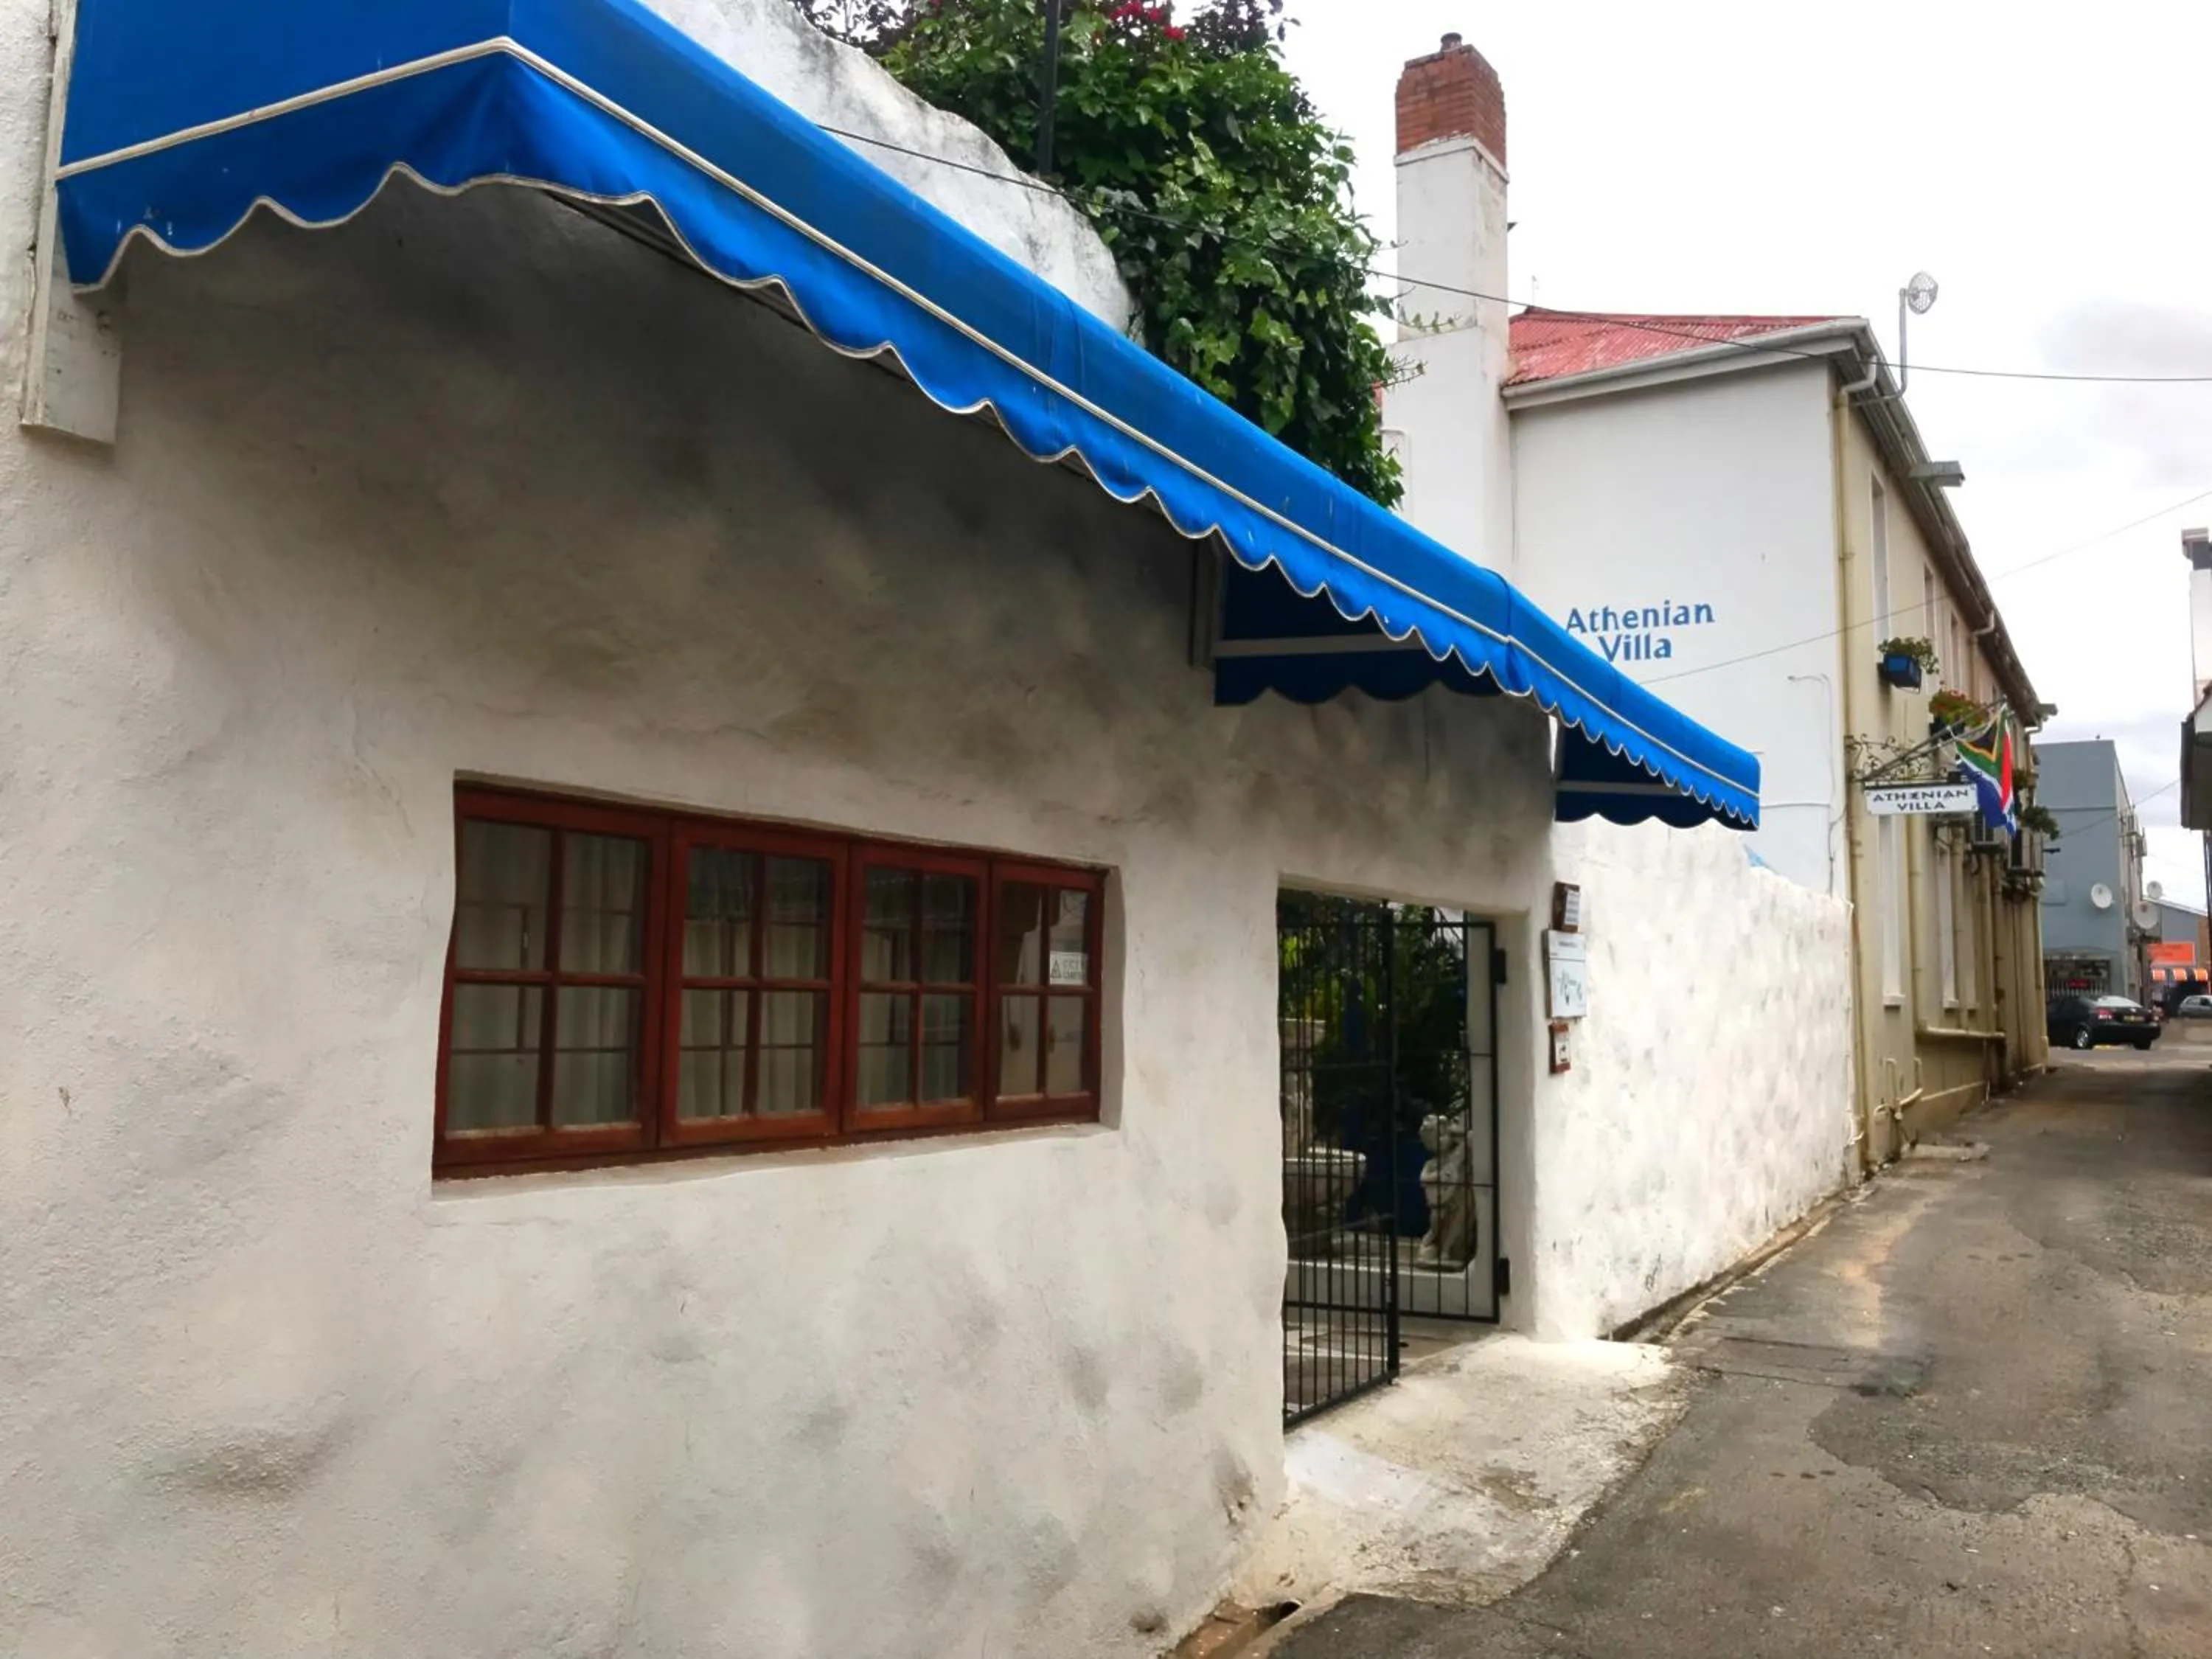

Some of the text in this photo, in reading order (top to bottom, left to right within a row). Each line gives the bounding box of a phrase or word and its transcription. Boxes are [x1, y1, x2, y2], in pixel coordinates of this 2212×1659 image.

[1566, 599, 1715, 633] Athenian
[1598, 633, 1672, 662] Villa
[1897, 801, 1945, 811] VILLA
